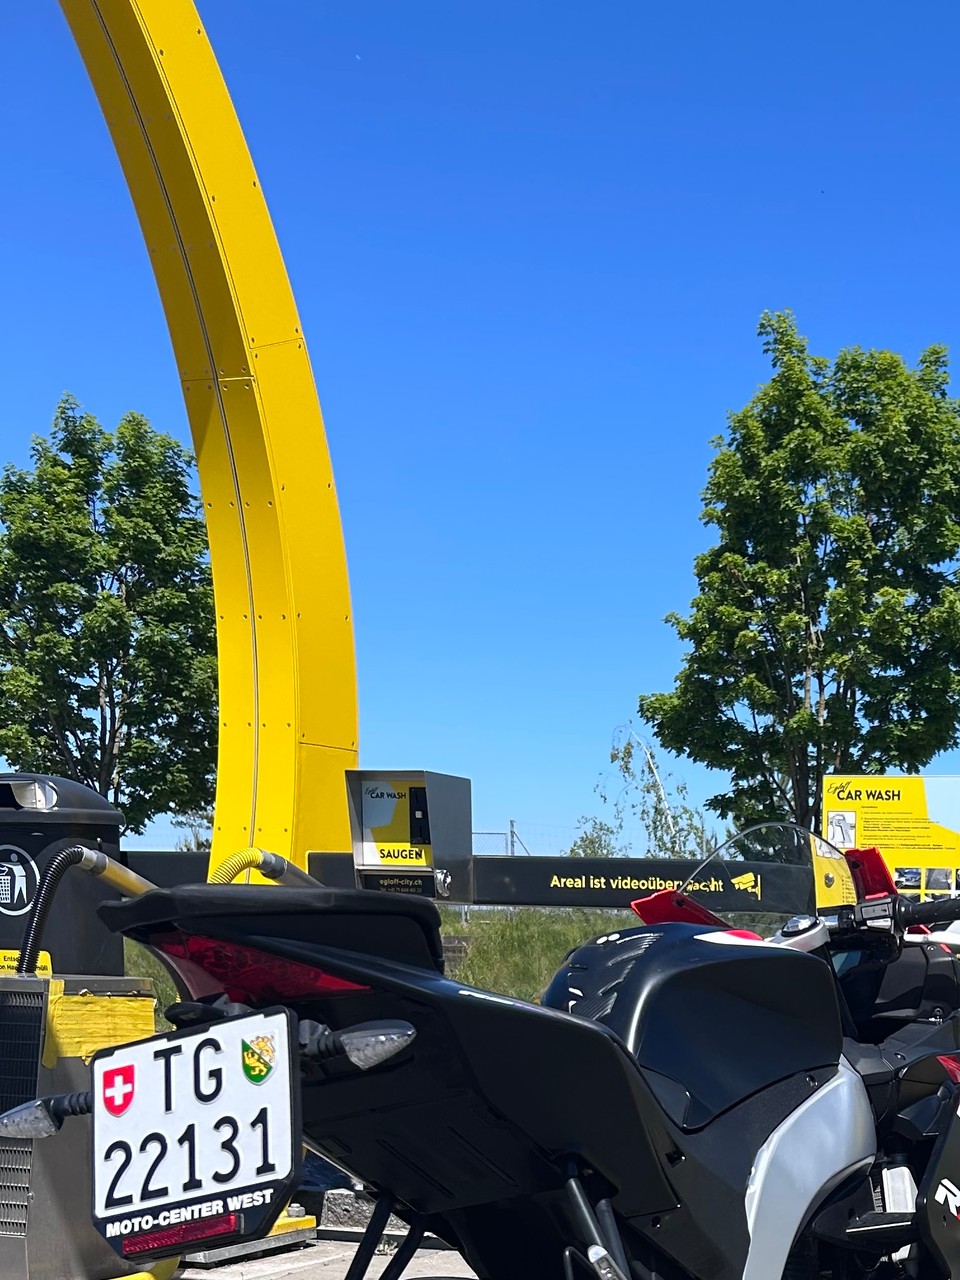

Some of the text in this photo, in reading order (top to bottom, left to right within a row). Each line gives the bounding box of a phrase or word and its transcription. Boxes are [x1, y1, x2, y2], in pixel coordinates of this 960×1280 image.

[837, 789, 901, 801] CAR WASH
[379, 849, 423, 860] SAUGEN
[550, 875, 586, 889] Areal
[590, 876, 606, 889] ist
[153, 1037, 223, 1113] TG
[103, 1106, 276, 1210] 22131
[105, 1188, 274, 1238] MOTO-CENTER WEST
